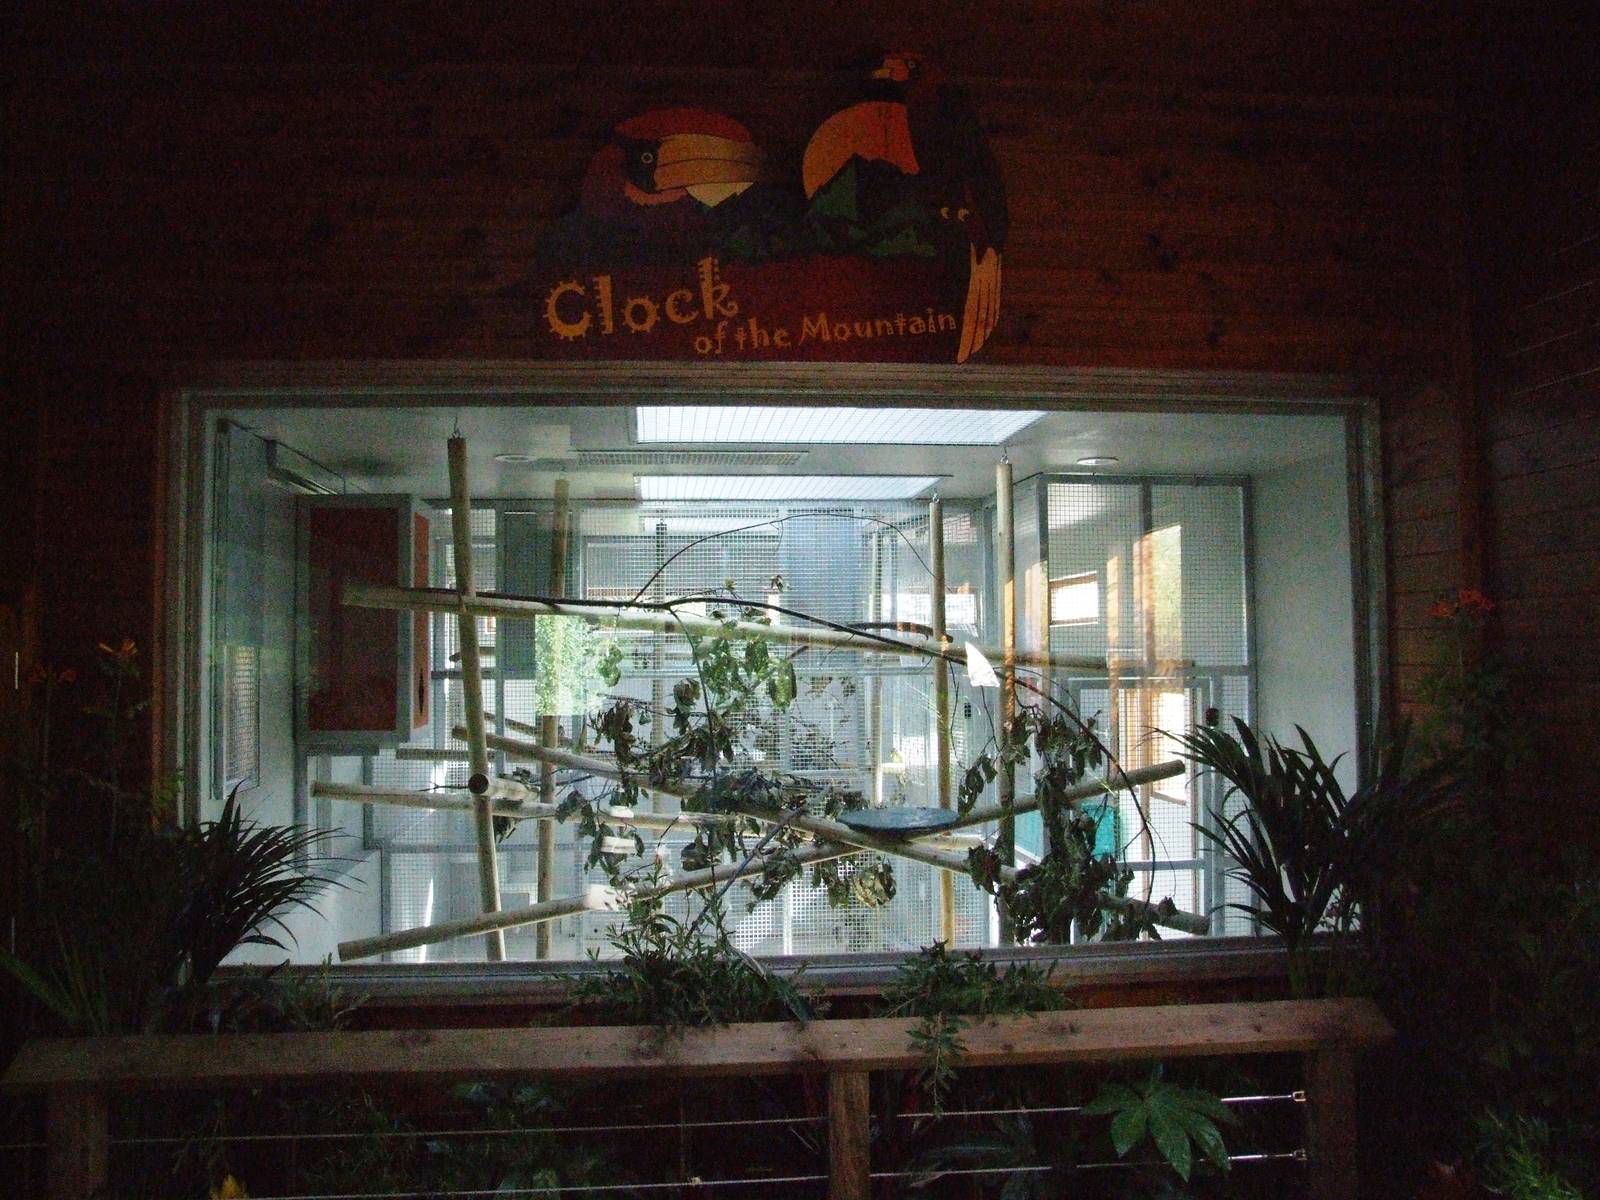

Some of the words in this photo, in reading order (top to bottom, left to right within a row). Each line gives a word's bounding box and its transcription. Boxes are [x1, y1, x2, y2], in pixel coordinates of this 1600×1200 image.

[544, 256, 739, 341] Clock
[694, 321, 729, 355] of
[735, 317, 792, 350] the
[800, 308, 957, 346] Mountain
